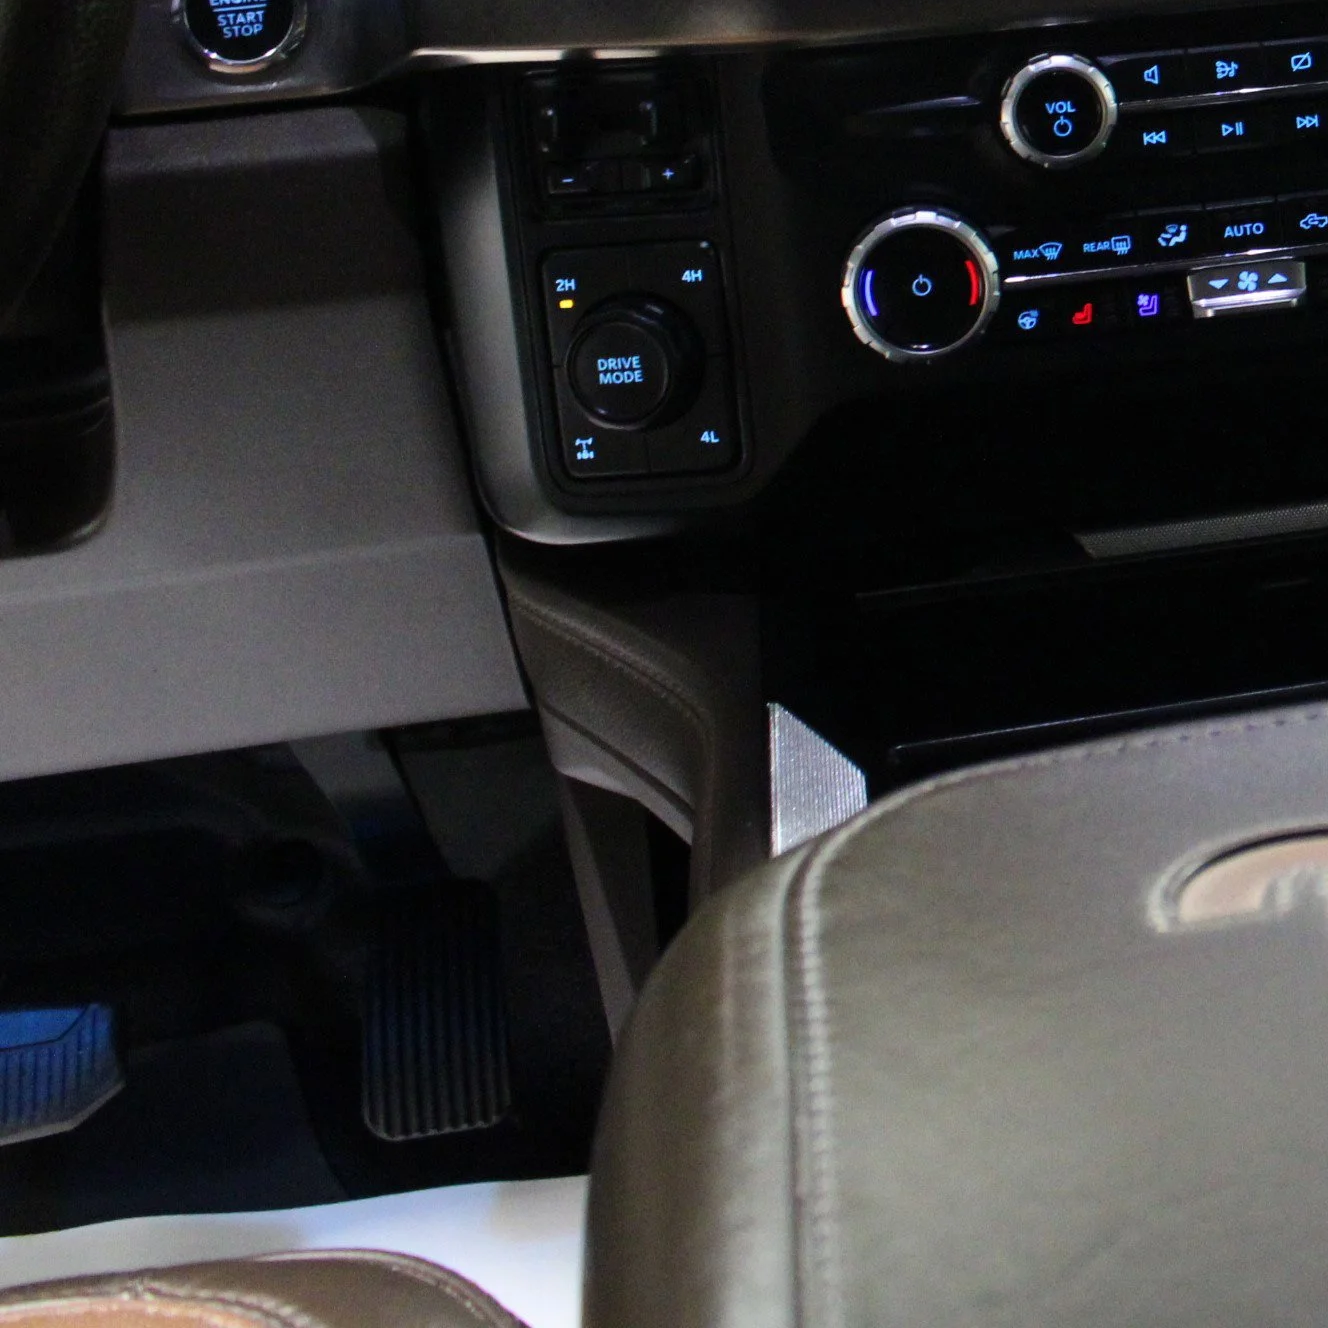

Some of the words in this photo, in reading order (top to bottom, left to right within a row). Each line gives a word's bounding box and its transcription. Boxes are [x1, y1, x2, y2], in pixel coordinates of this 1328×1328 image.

[216, 9, 265, 27] START
[222, 23, 264, 39] STOP
[1044, 100, 1077, 115] VOL
[1223, 222, 1265, 238] AUTO
[1082, 240, 1112, 253] REAR
[1013, 248, 1041, 261] MAX
[681, 269, 704, 283] 4H
[555, 278, 577, 292] 2H
[597, 354, 643, 371] DRIVE
[598, 369, 644, 385] MODE
[700, 430, 720, 444] 4L
